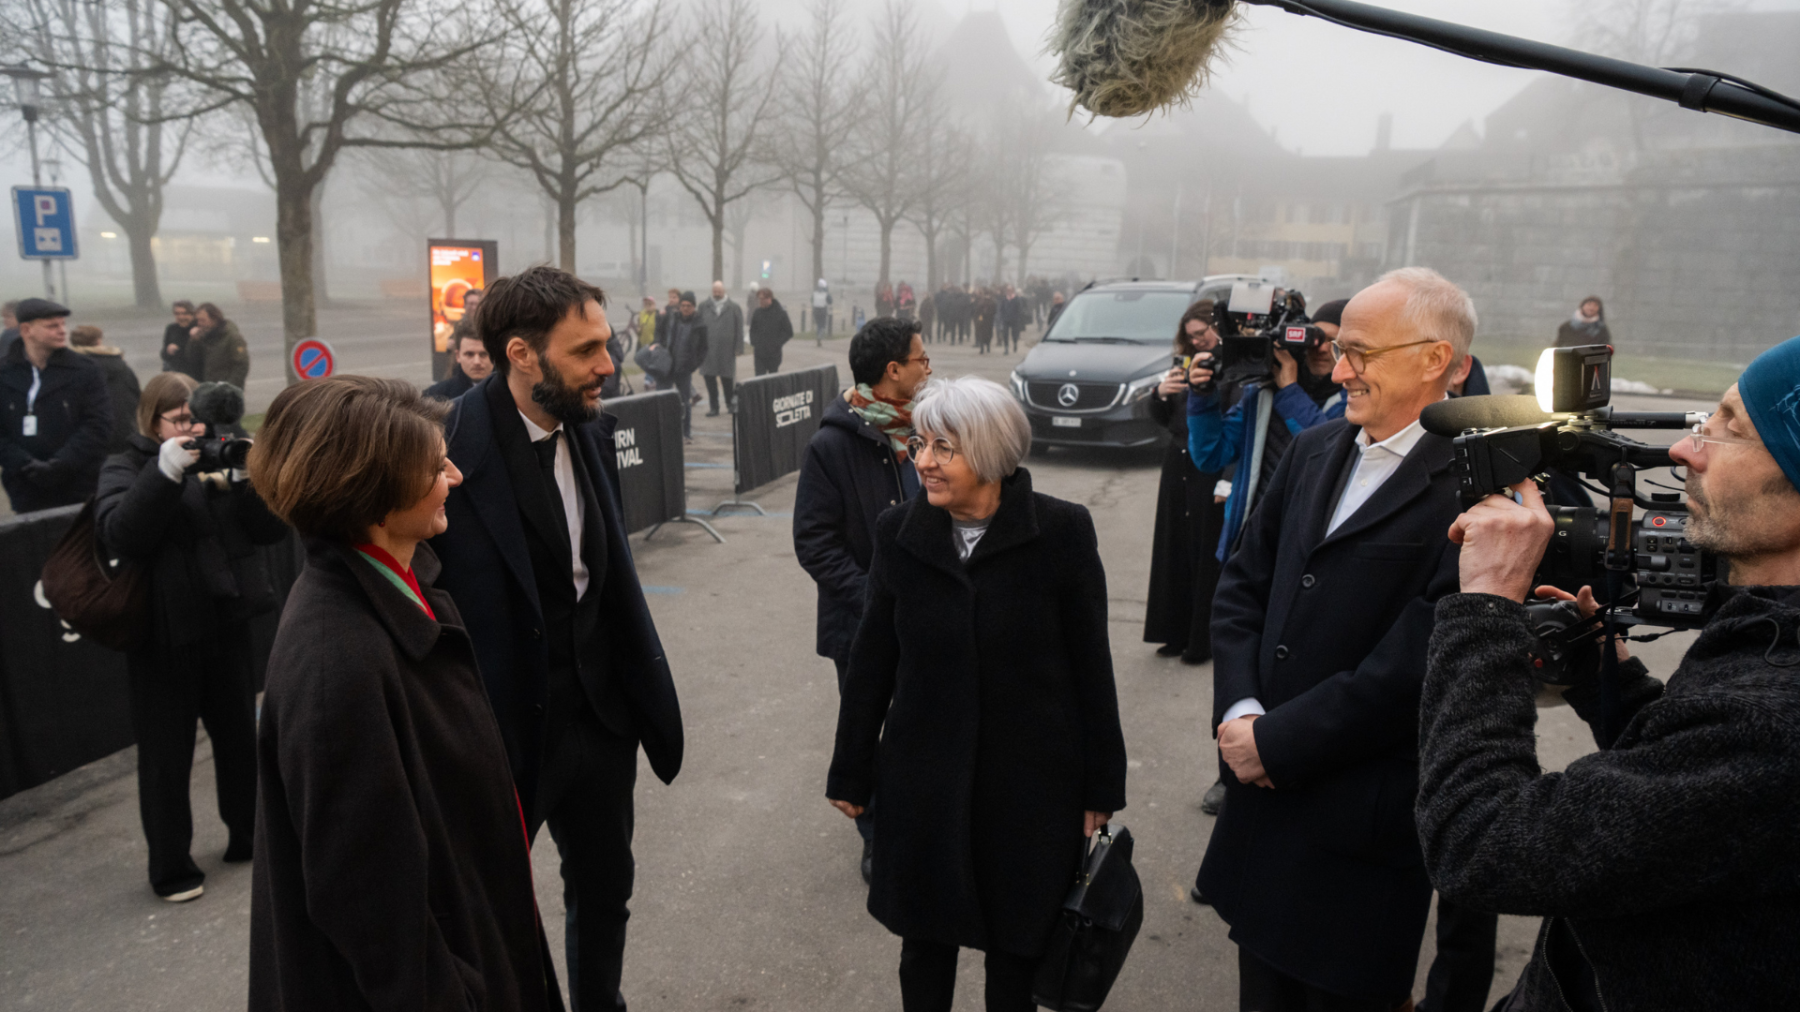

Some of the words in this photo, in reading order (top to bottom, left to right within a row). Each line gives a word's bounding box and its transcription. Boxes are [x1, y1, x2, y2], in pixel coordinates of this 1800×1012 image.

[34, 195, 58, 227] P
[1288, 330, 1303, 338] SRF
[773, 391, 805, 413] GIORNATE
[806, 390, 814, 404] DI
[616, 447, 643, 470] IVAL
